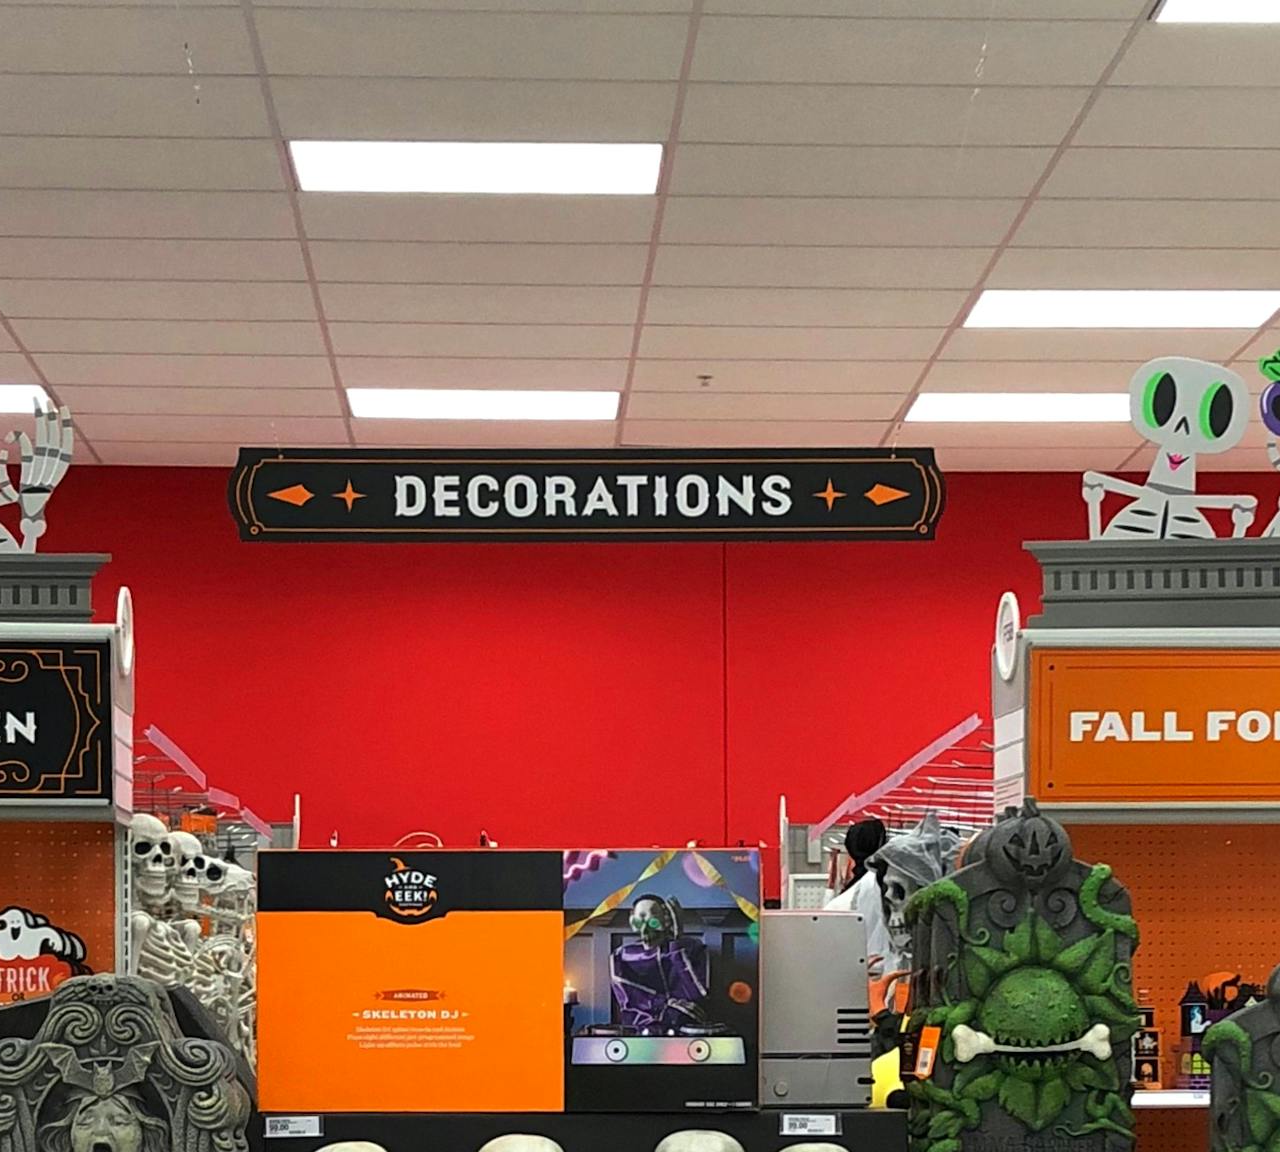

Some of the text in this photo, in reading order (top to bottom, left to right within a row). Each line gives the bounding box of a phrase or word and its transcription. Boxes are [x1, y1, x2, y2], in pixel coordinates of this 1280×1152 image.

[394, 474, 792, 517] DECORATIONS
[1070, 711, 1193, 742] FALL
[384, 871, 438, 889] HYDE
[394, 890, 428, 902] EEK!
[362, 1009, 459, 1019] SKELETON DJ
